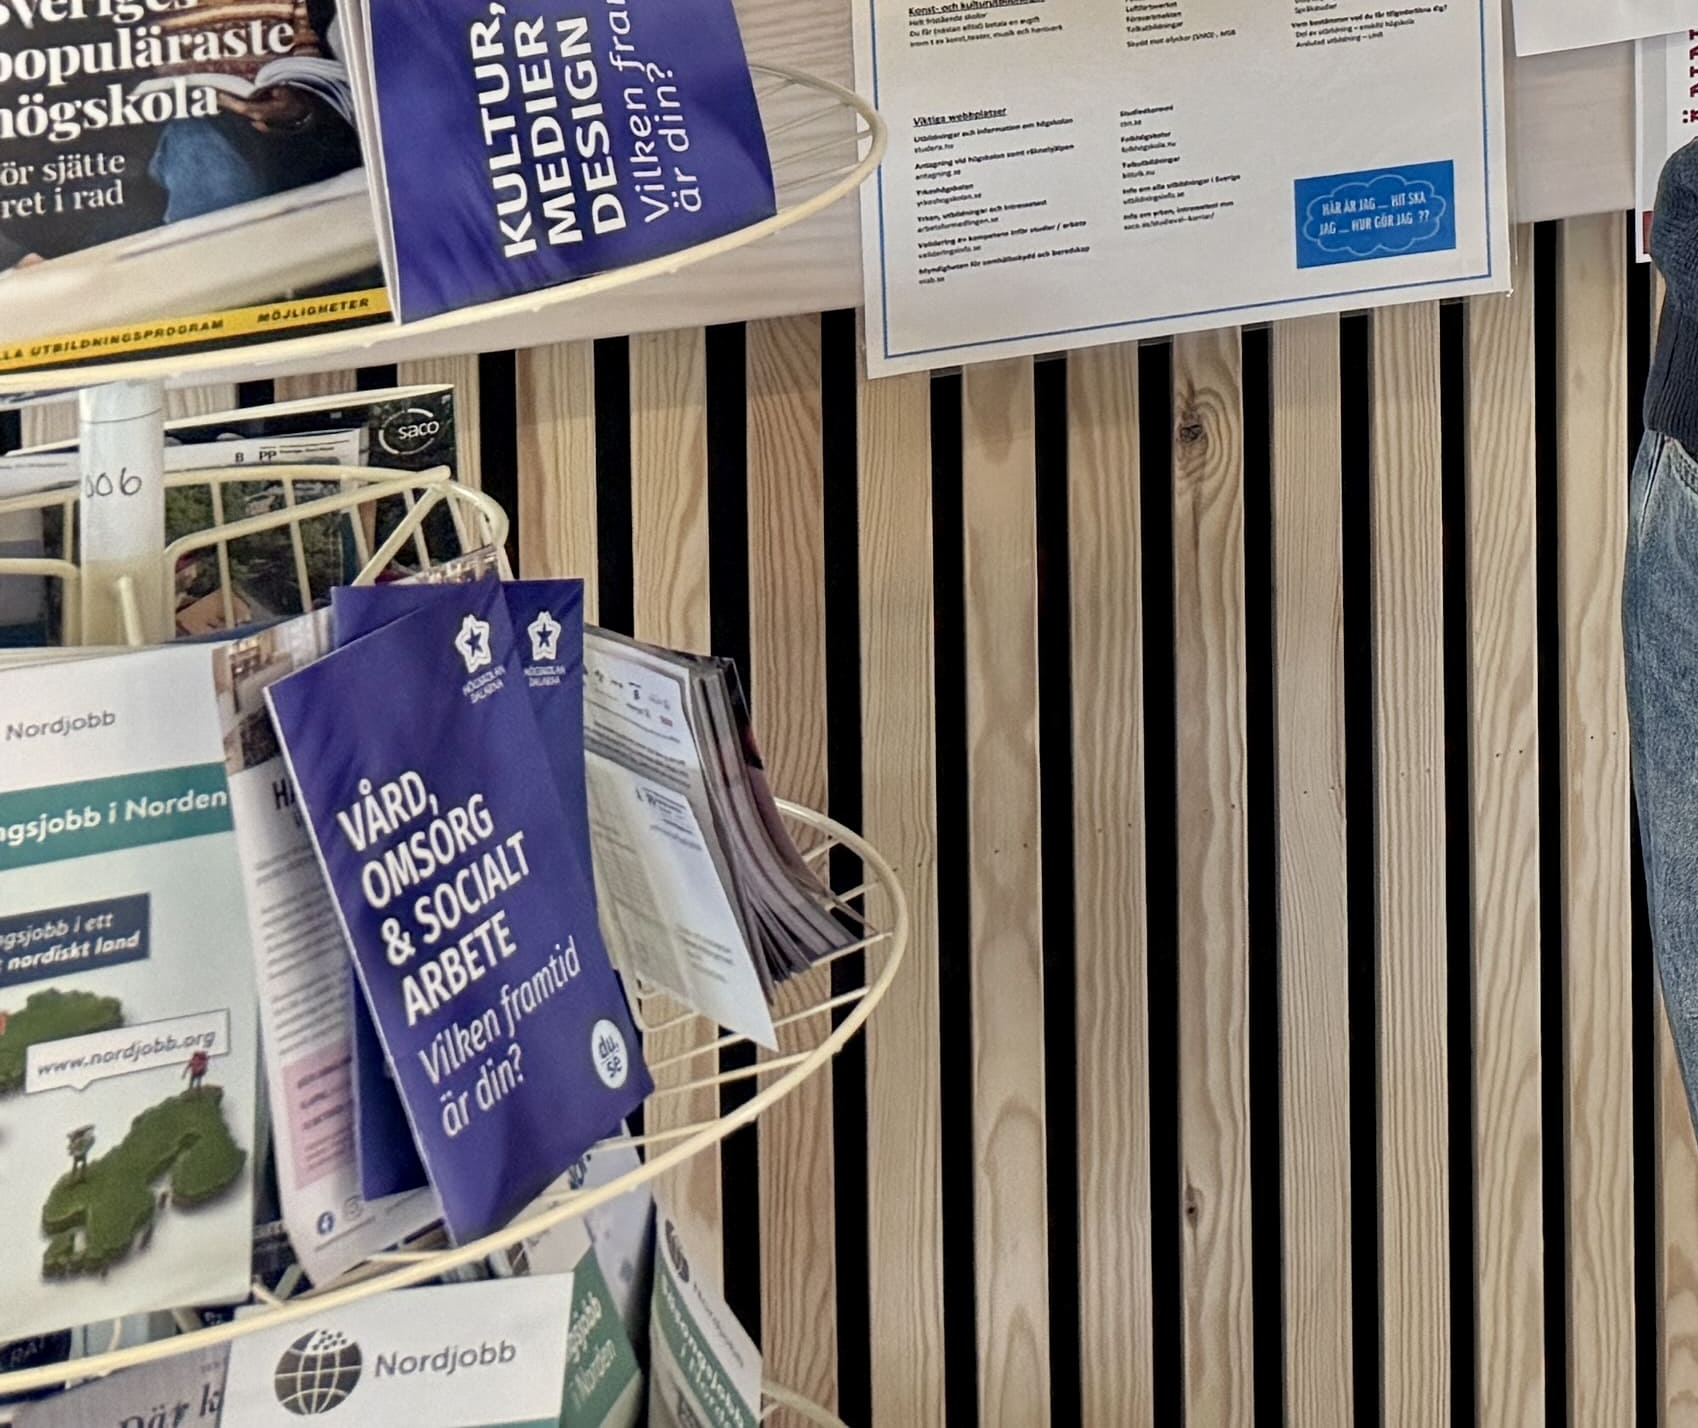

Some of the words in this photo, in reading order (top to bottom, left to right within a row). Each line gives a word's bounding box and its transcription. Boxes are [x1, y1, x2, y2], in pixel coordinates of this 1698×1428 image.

[470, 1, 538, 258] KULTUR,
[514, 15, 584, 245] MEDIER
[556, 17, 626, 234] DESIGN
[646, 63, 690, 152] din?
[0, 162, 33, 186] ör
[42, 154, 126, 185] sjätte
[623, 87, 669, 223] Vilken
[673, 167, 701, 212] är
[0, 192, 46, 218] ret
[54, 188, 62, 212] i
[73, 180, 124, 210] rad
[30, 319, 224, 356] UTBILDNINGSPROGRAM
[258, 298, 370, 323] MÖJLIGHETER
[398, 419, 439, 440] saco
[6, 709, 116, 742] Nordjobb
[109, 801, 118, 825] i
[124, 787, 228, 822] Norden
[336, 770, 441, 853] VÅRD,
[360, 793, 495, 909] OMSORG
[73, 916, 81, 933] i
[85, 913, 114, 933] ett
[380, 917, 416, 966] &
[413, 830, 532, 947] SOCIALT
[8, 937, 91, 971] nordiskt
[95, 930, 141, 954] land
[402, 909, 517, 1027] ARBETE
[417, 1014, 500, 1087] Vilken
[499, 935, 582, 1040] framtid
[37, 1029, 216, 1077] www.nordjobb.org
[440, 1090, 472, 1138] är
[478, 1043, 525, 1114] din?
[373, 1339, 517, 1378] Nordjobb
